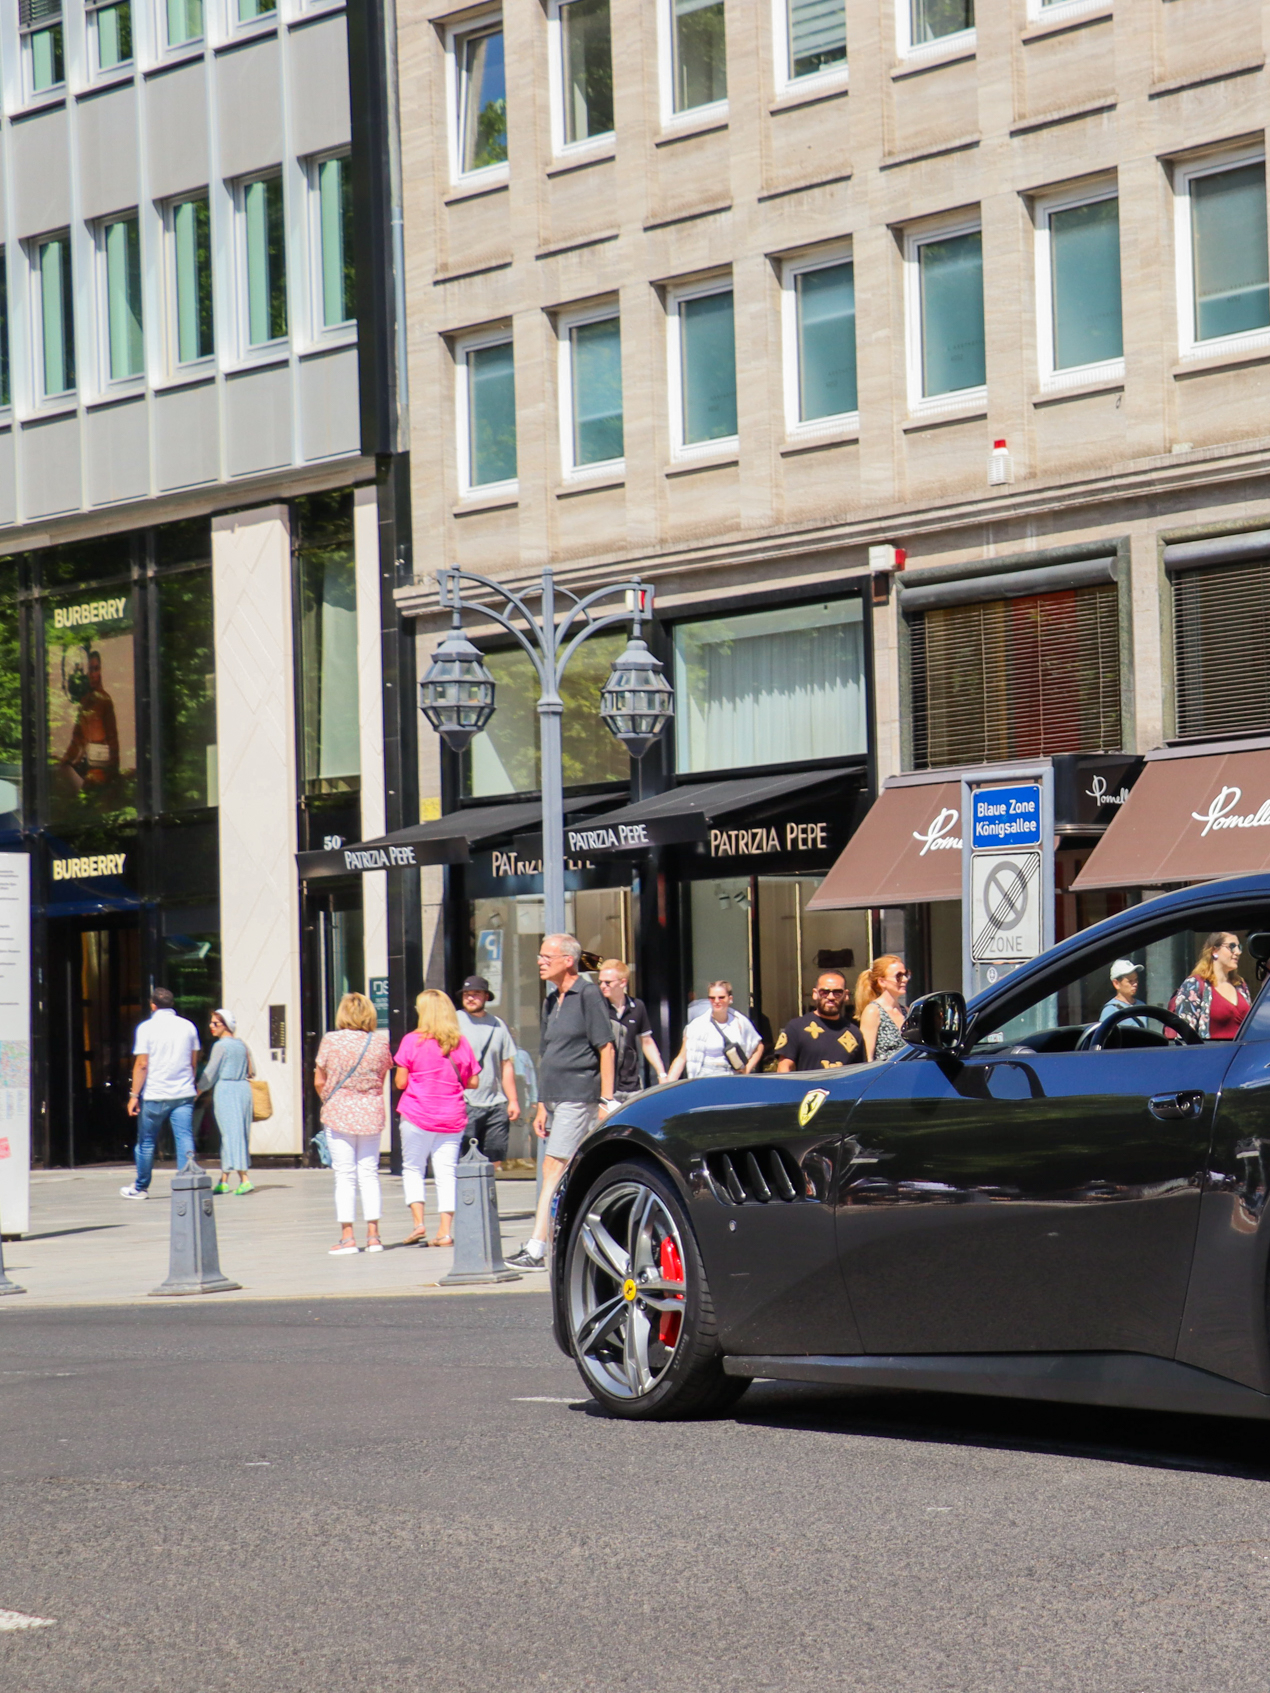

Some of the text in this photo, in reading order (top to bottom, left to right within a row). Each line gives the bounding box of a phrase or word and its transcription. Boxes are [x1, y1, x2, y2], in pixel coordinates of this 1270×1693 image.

[54, 597, 127, 629] BURBERRY
[1085, 775, 1130, 806] Pomell
[977, 799, 1036, 818] Blaue Zone
[568, 824, 650, 851] PATRIZIA PEPE
[711, 823, 828, 857] PATRIZIA PEPE
[975, 818, 1037, 838] Königsallee
[323, 835, 341, 851] 50
[52, 853, 126, 881] BURBERRY
[344, 846, 417, 870] PATRIZIA PEPE
[989, 936, 1023, 953] ZONE
